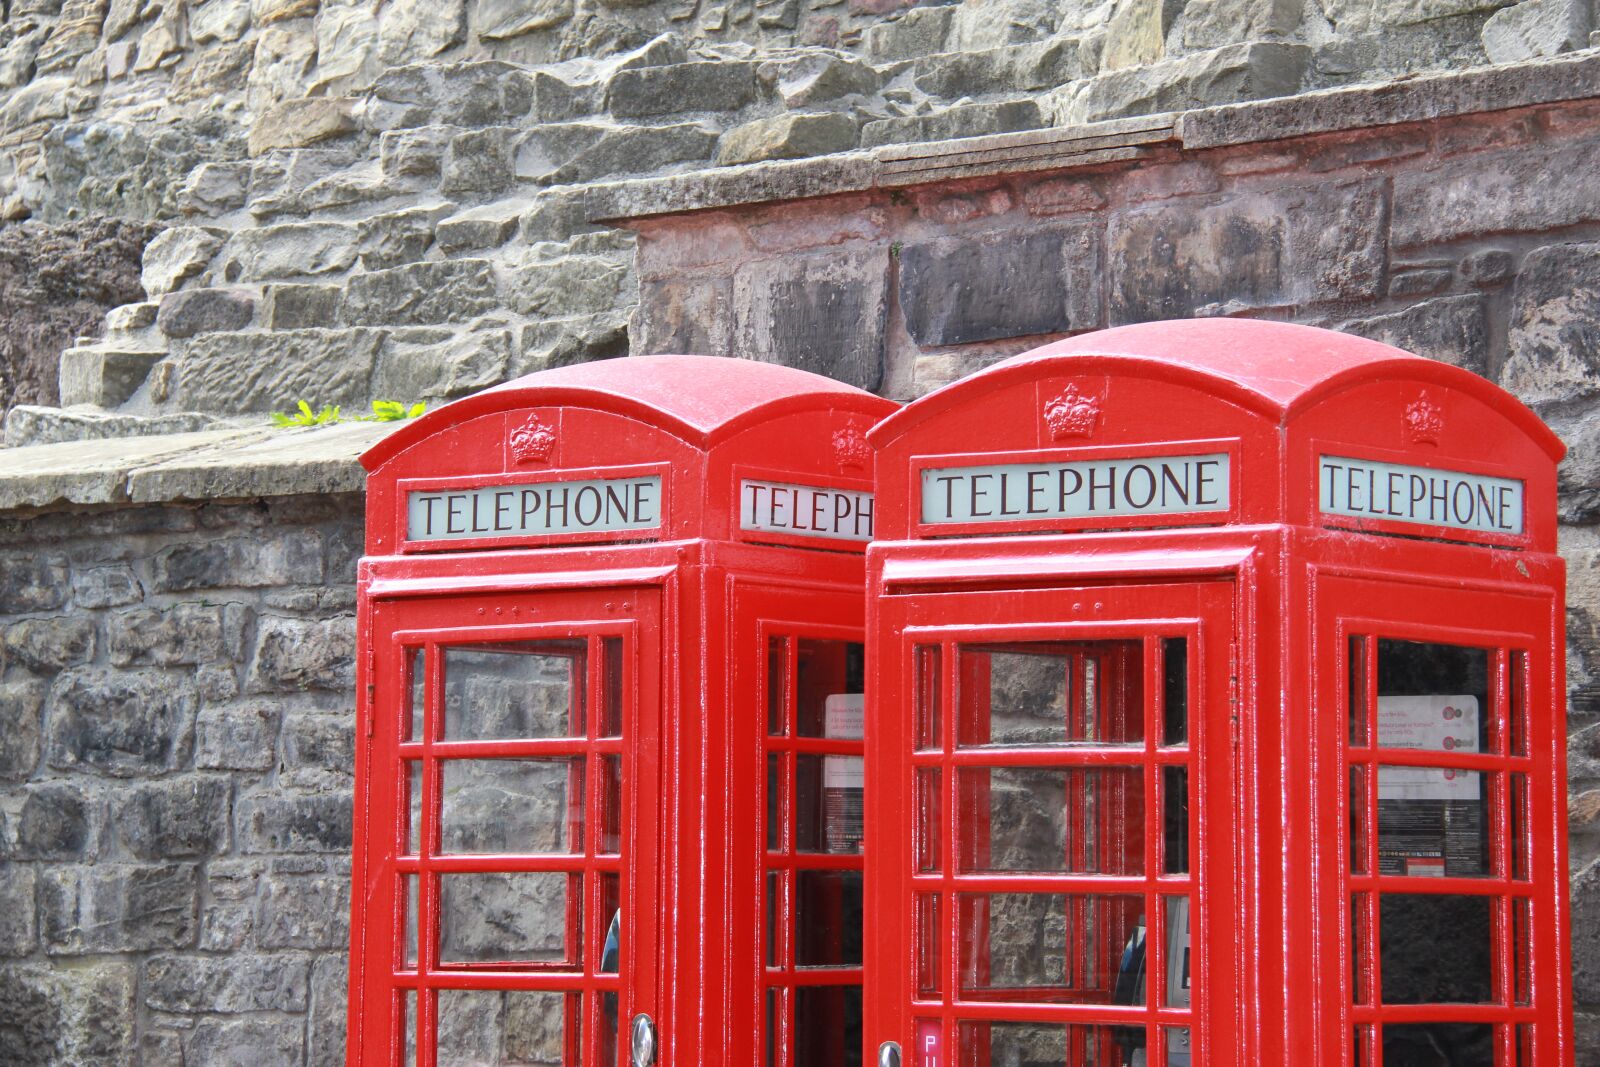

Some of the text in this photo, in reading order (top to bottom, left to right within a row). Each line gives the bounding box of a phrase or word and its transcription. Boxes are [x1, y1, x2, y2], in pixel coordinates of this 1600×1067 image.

[419, 482, 654, 536] TELEPHONE
[745, 484, 875, 537] TELEPH
[936, 460, 1219, 518] TELEPHONE
[1322, 464, 1513, 530] TELEPHONE
